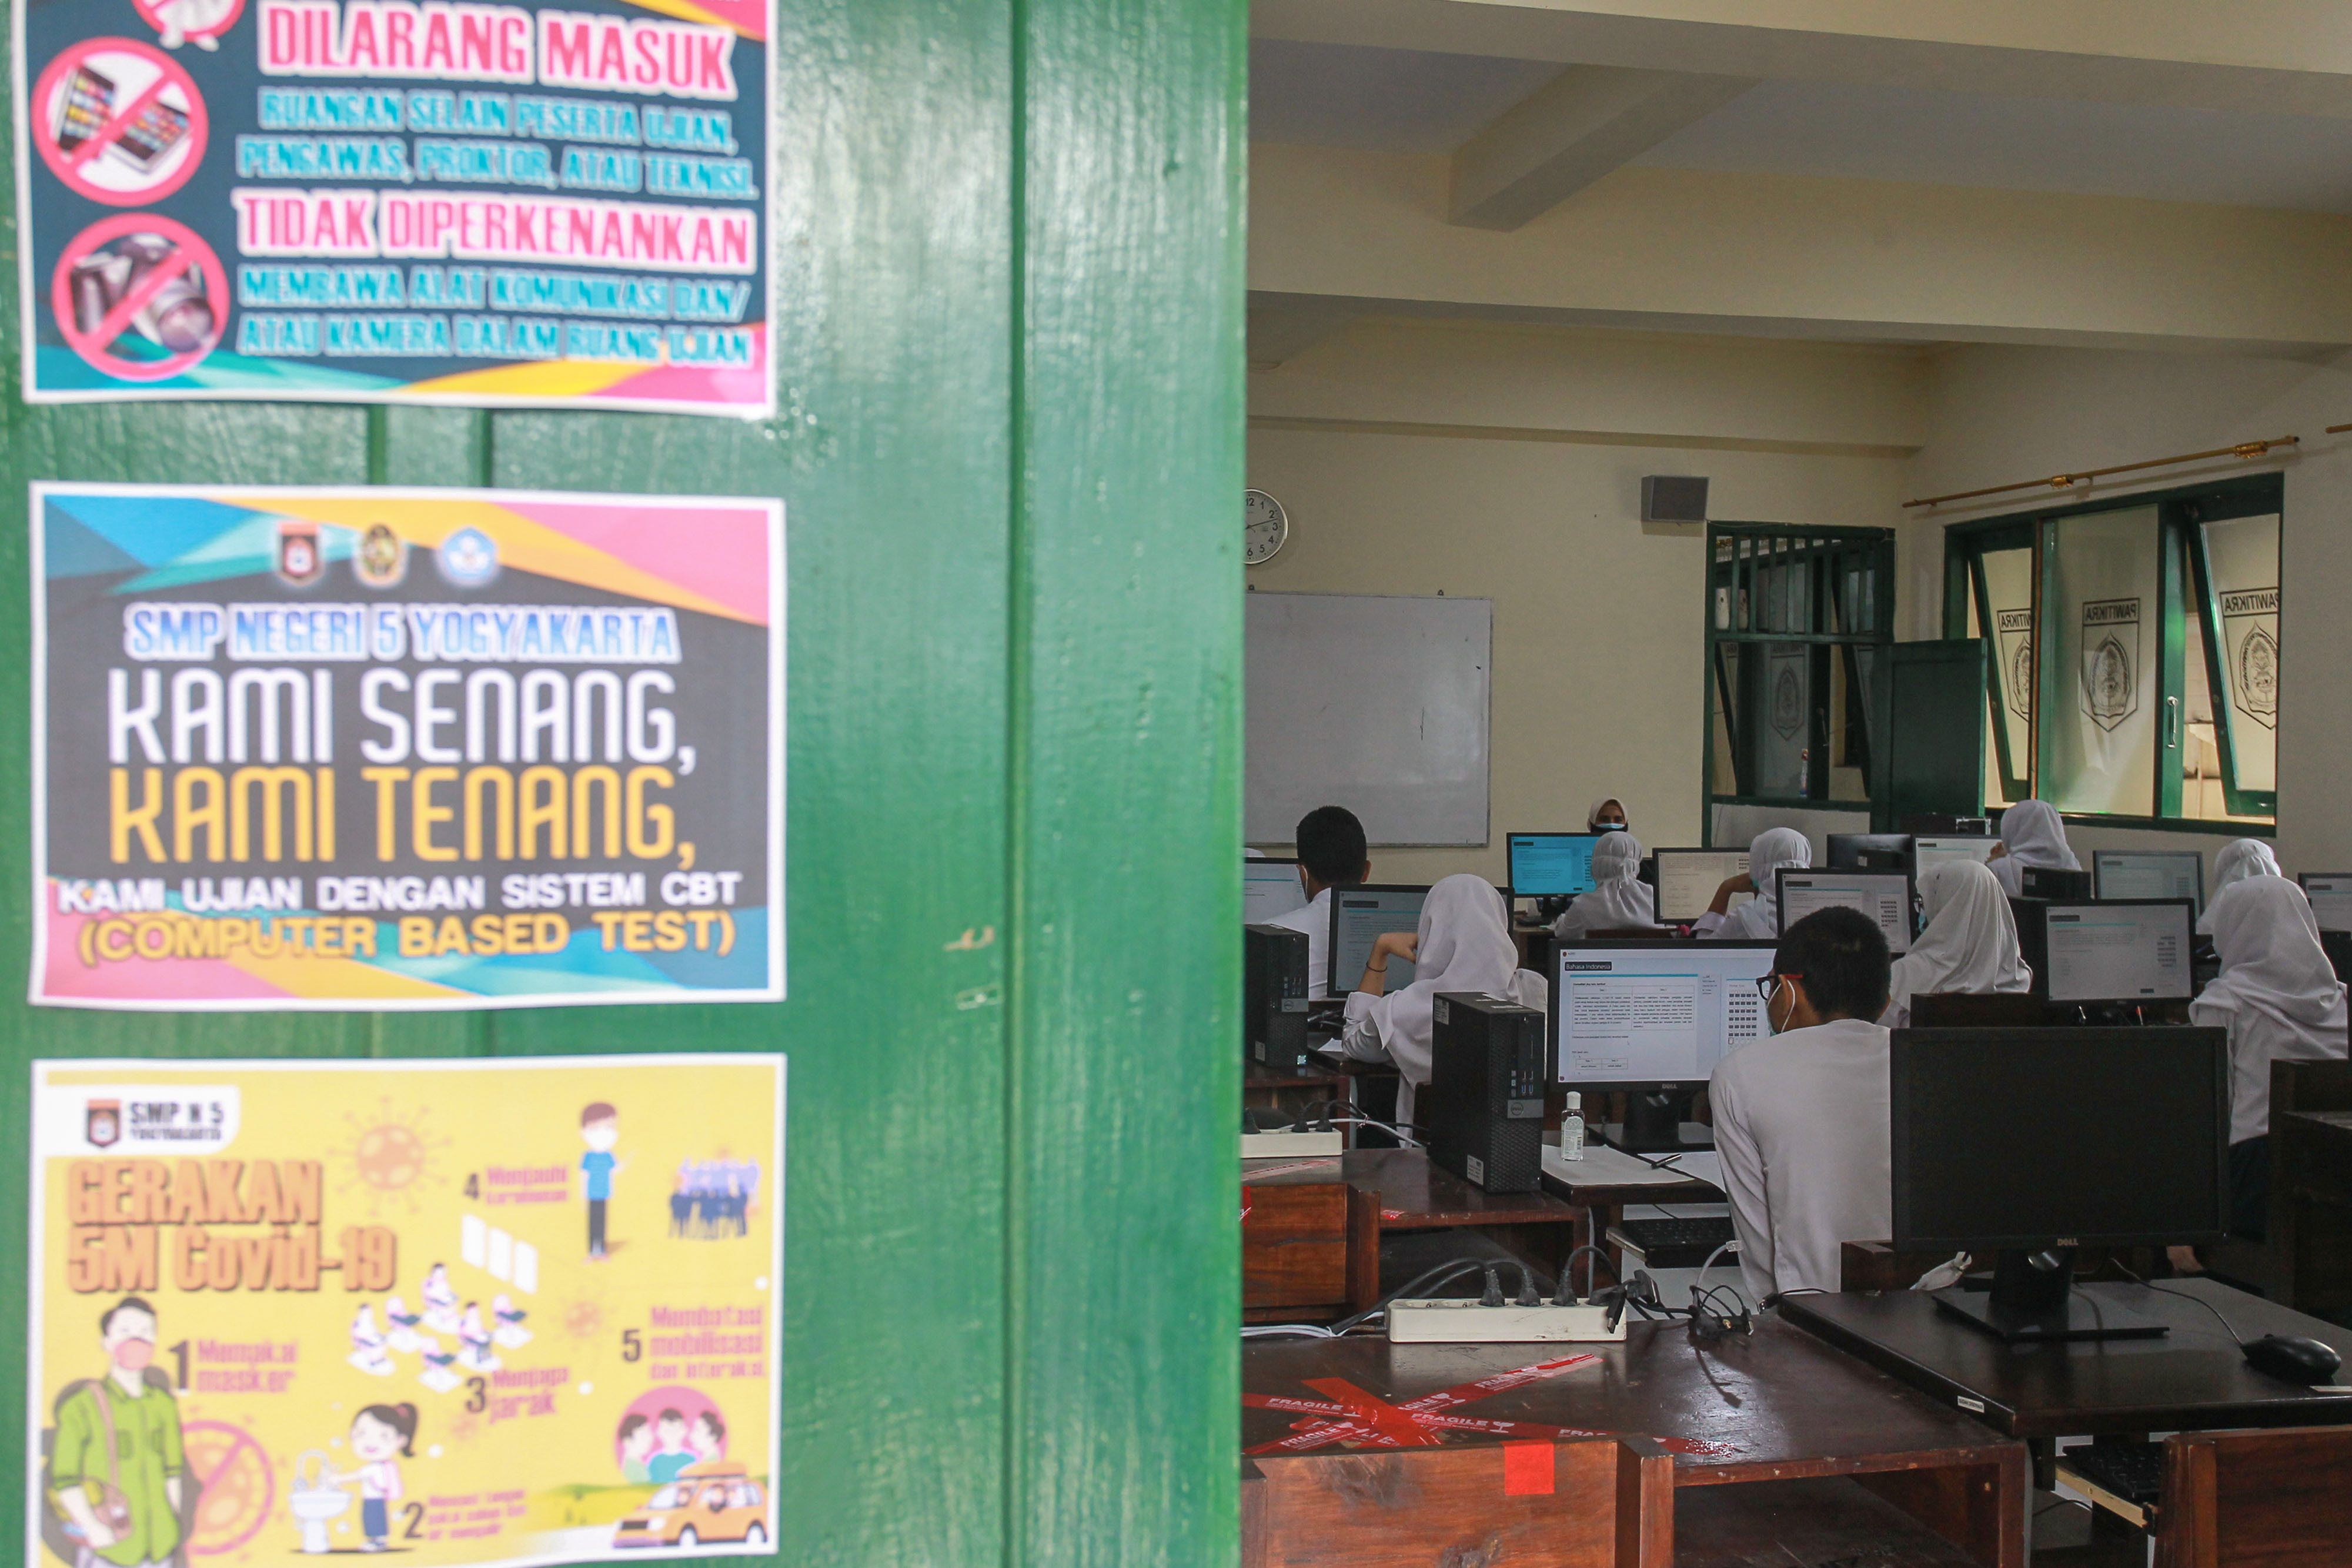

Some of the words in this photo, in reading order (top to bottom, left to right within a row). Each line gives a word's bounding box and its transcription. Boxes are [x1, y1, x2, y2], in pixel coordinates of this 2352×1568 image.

[265, 5, 528, 78] DILARANG
[543, 16, 731, 94] MASUK
[517, 98, 639, 141] PESERTA
[563, 149, 639, 189] ATAU
[238, 194, 374, 252] TIDAK
[383, 195, 751, 269] DIPERKENANKAN
[241, 267, 403, 303] MEMBAWA
[412, 269, 482, 305] ALAT
[240, 316, 318, 352] ATAU
[326, 316, 449, 352] KAMERA
[456, 317, 557, 356] DALAM
[1261, 501, 1264, 509] 1
[1269, 510, 1275, 518] 2
[1247, 547, 1253, 556] 6
[1259, 544, 1265, 553] 5
[1268, 536, 1274, 544] 4
[129, 606, 222, 657] SMP
[232, 606, 367, 657] NEGERI
[375, 606, 402, 657] 5
[410, 607, 677, 660] YOGYAKARTA
[108, 667, 333, 765] KAMI
[359, 667, 696, 776] SENANG,
[109, 766, 335, 864] KAMI
[360, 765, 696, 870] TENANG,
[58, 878, 166, 914] KAMI
[181, 876, 302, 912] UJIAN
[316, 875, 485, 911] DENGAN
[501, 872, 646, 908] SISTEM
[660, 871, 743, 905] CBT
[78, 915, 377, 968] (COMPUTER
[398, 913, 570, 958] BASED
[592, 910, 736, 957] TEST)
[131, 1101, 180, 1124] SMP
[211, 1101, 225, 1124] 5
[68, 1159, 323, 1226] GERAKAN
[463, 1172, 480, 1201] 4
[68, 1226, 159, 1293] 5M
[176, 1224, 398, 1293] Covid-19
[2057, 1238, 2079, 1246] DELL
[622, 1329, 642, 1363] 5
[167, 1340, 191, 1391] 1
[465, 1376, 487, 1413] 3
[1268, 1398, 1344, 1411] FRAGILE
[1279, 1425, 1342, 1447] FRAGILE
[1411, 1413, 1489, 1427] FRAGILE
[403, 1502, 426, 1540] 2
